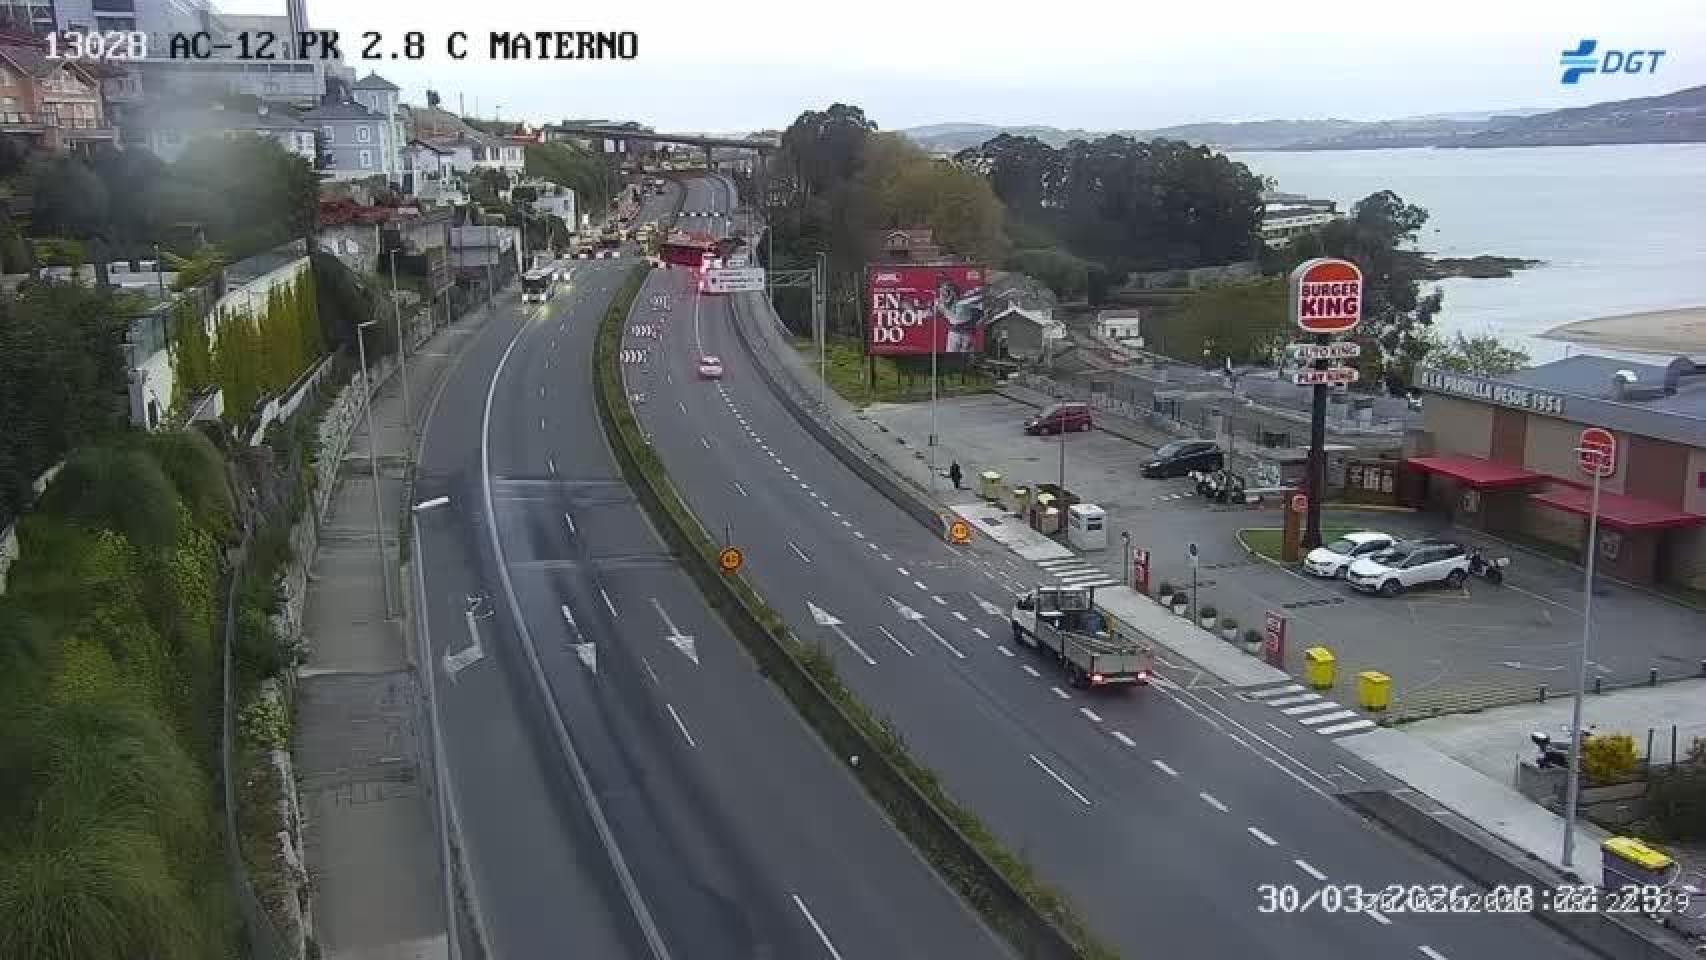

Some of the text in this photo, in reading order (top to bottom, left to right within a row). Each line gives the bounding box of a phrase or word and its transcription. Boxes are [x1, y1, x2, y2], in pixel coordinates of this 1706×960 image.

[1301, 283, 1359, 297] BURGER
[873, 293, 900, 309] EN
[1301, 297, 1358, 317] KING
[873, 327, 904, 343] DO
